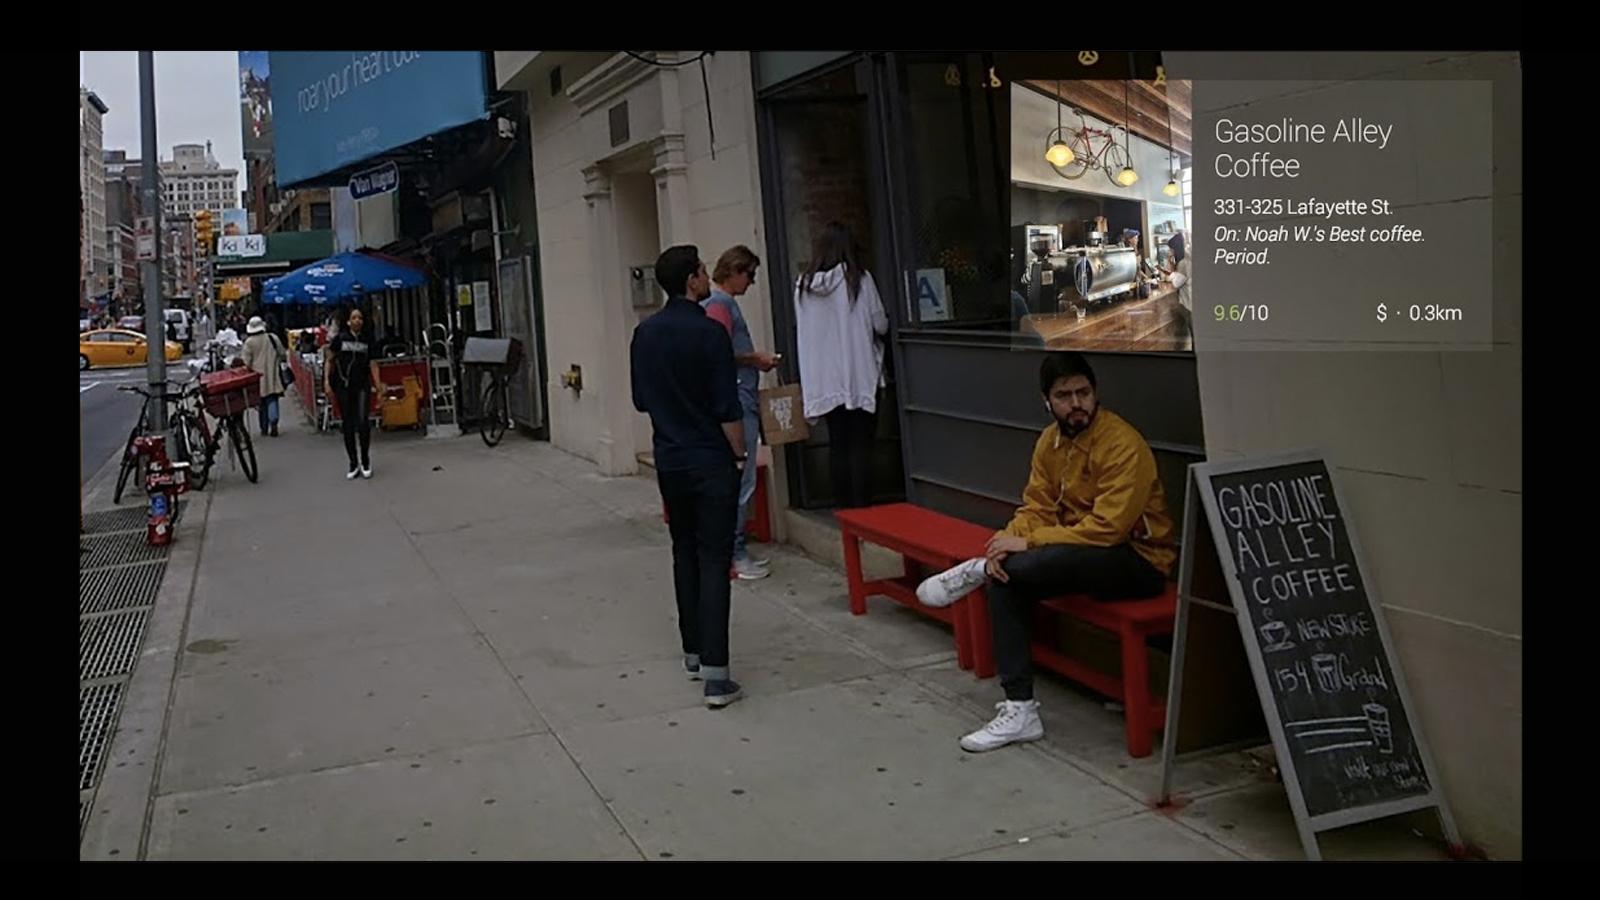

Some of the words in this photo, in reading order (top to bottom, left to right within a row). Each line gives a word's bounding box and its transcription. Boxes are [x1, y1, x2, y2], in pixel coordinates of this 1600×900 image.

[297, 80, 321, 113] roar
[321, 64, 351, 112] your
[917, 276, 940, 307] A
[1218, 474, 1336, 529] GASOLINE
[1236, 521, 1336, 573] ALLEY
[1252, 563, 1355, 604] COFFEE
[1296, 617, 1332, 642] NEW
[1274, 659, 1313, 694] 154
[1338, 652, 1388, 691] Grand
